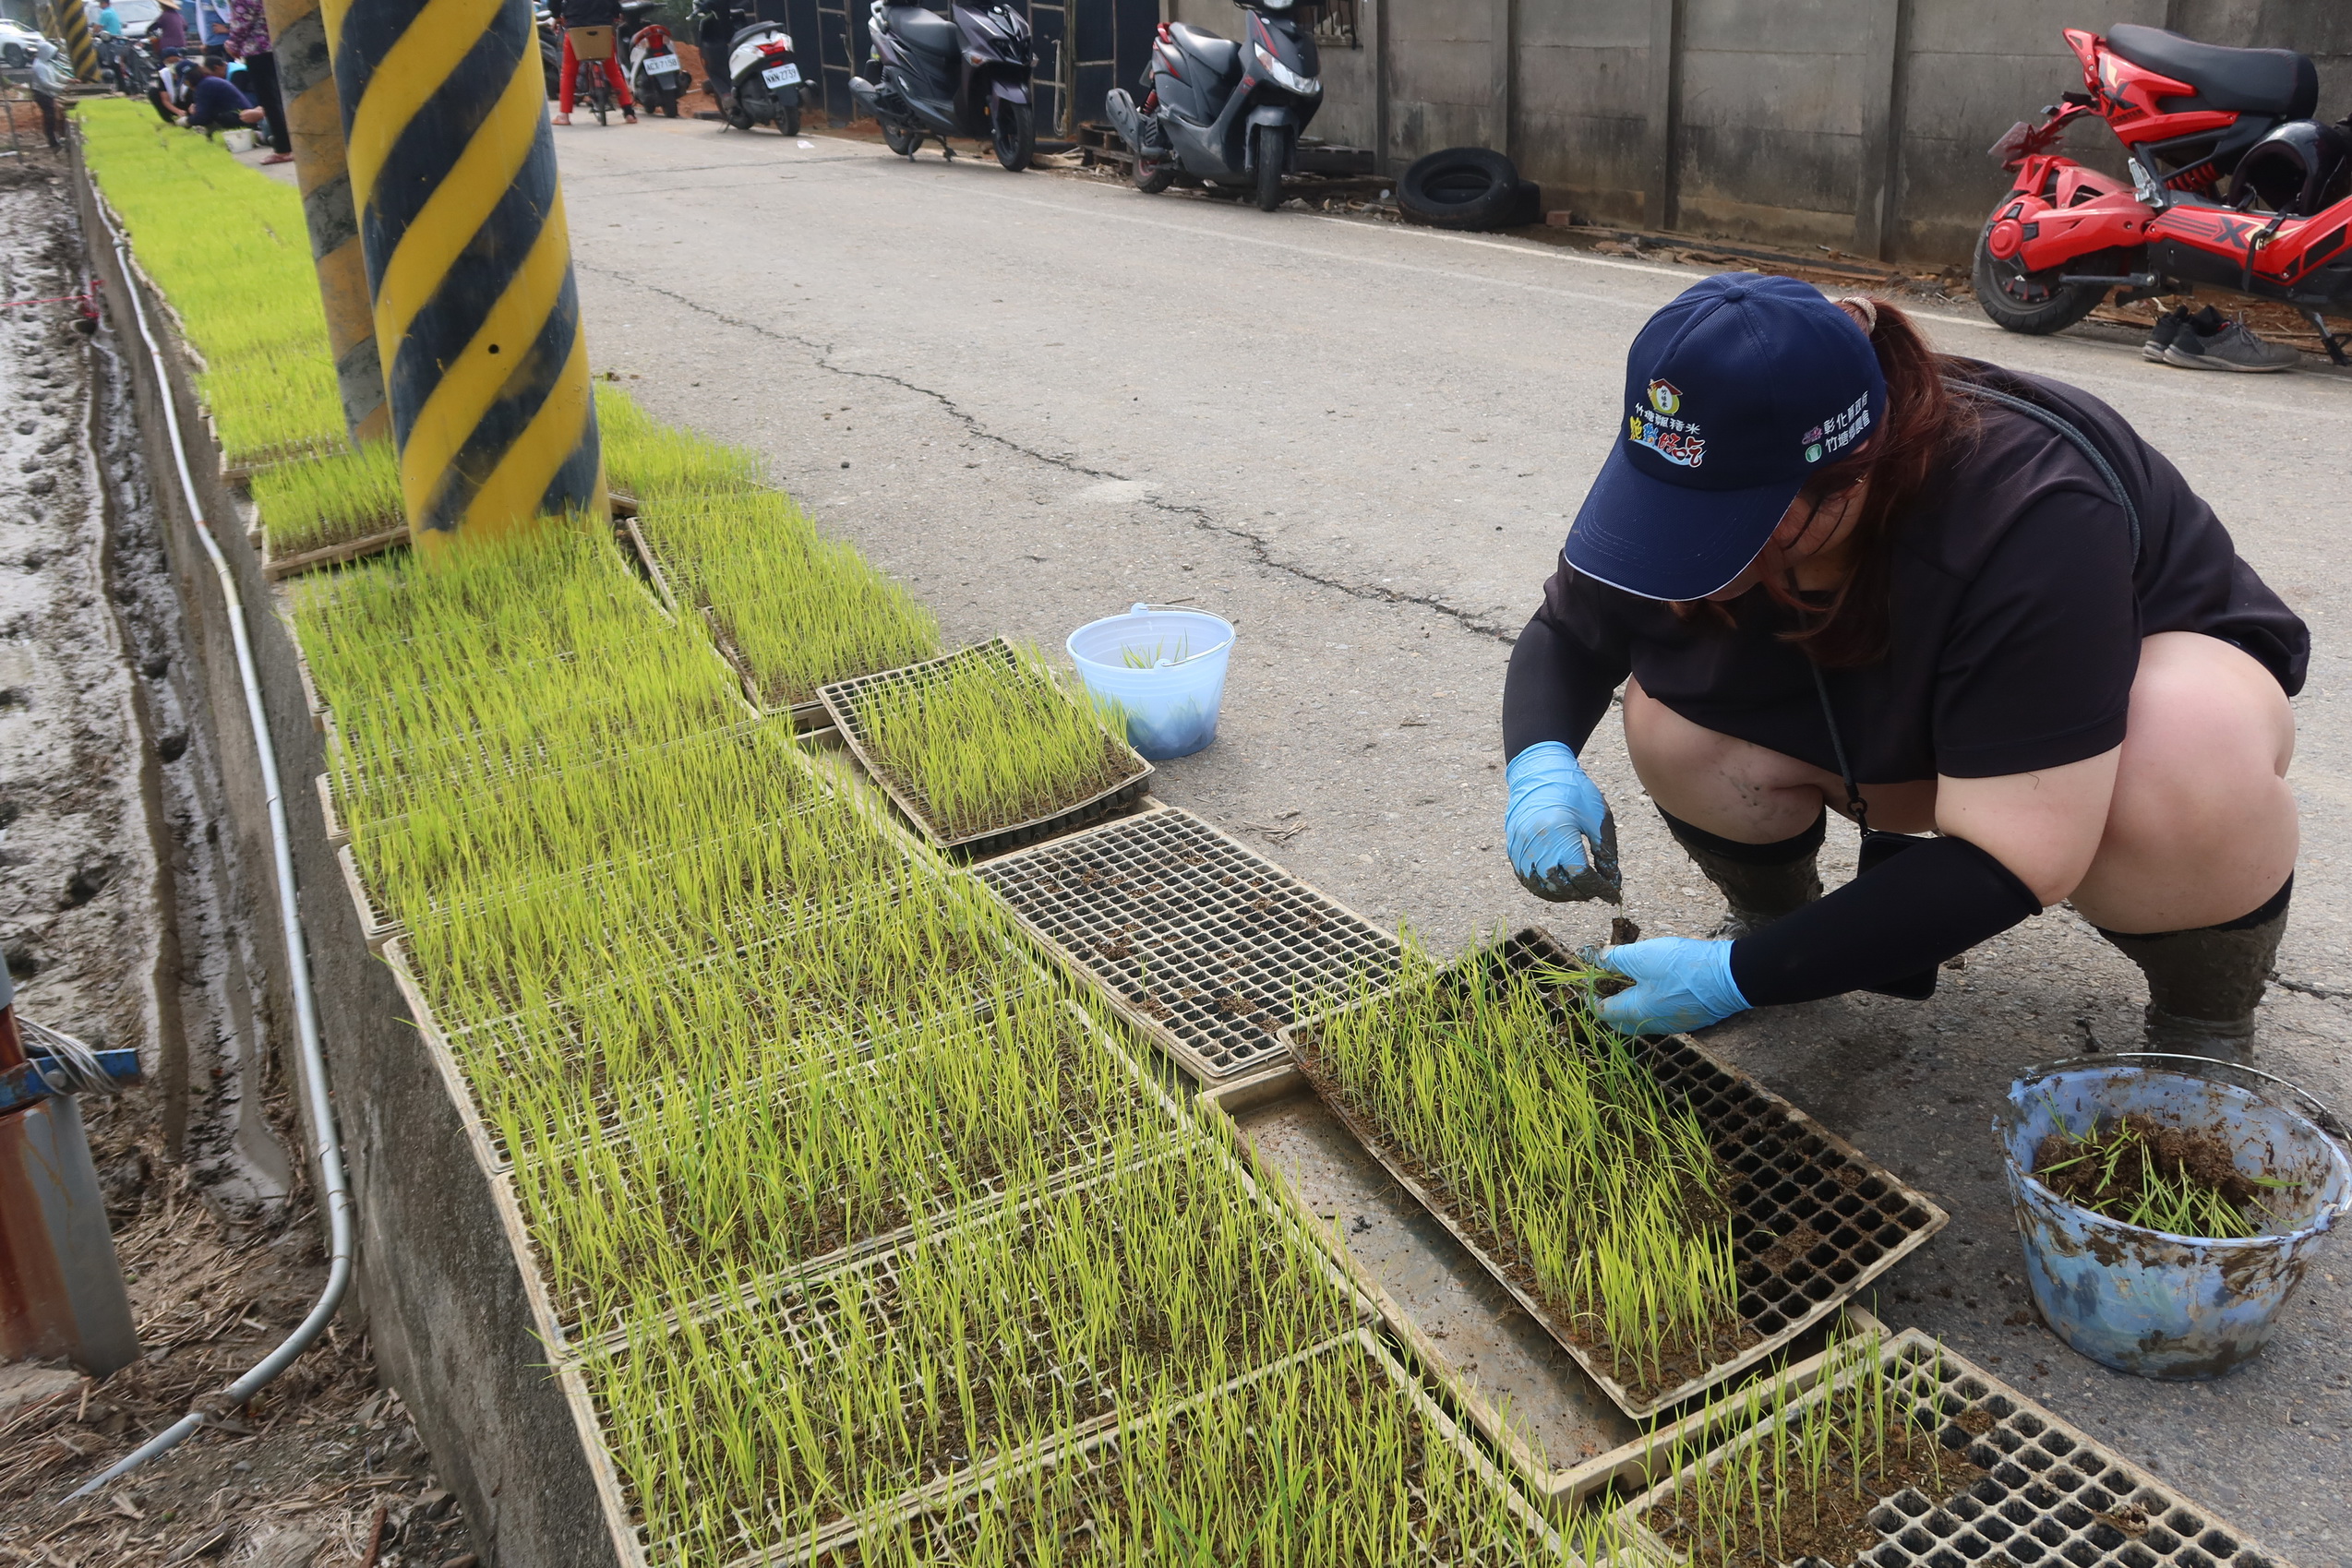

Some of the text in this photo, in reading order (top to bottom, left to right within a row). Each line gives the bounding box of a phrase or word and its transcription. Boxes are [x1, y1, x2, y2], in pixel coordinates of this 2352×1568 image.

[1825, 410, 1870, 453] 竹塘鄉農會
